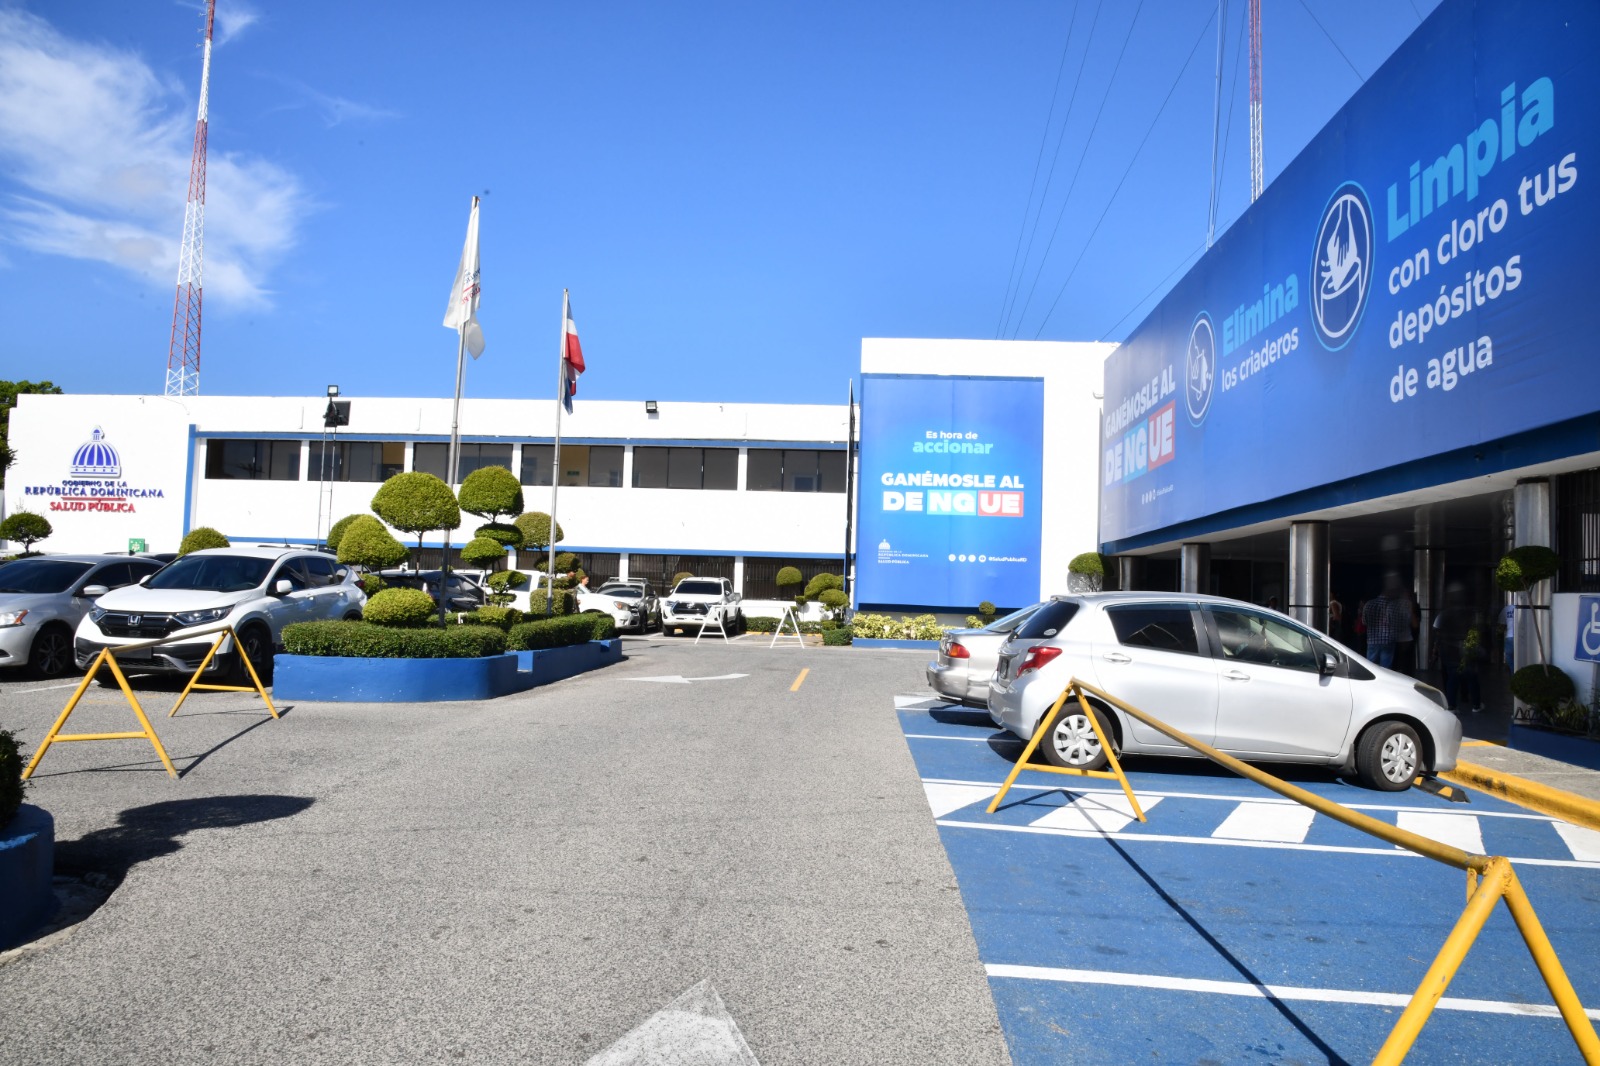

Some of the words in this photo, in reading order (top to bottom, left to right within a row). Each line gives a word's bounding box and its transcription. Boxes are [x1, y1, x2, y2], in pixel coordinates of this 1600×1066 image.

[1387, 76, 1554, 243] Limpia
[1388, 248, 1430, 295] con
[1437, 198, 1508, 265] cloro
[1518, 152, 1578, 216] tus
[1223, 273, 1299, 357] Elimina
[1389, 254, 1523, 349] depósitos
[1222, 366, 1237, 393] los
[1240, 327, 1299, 381] criaderos
[1389, 364, 1418, 403] de
[1426, 335, 1493, 392] agua
[925, 431, 938, 439] Es
[940, 431, 962, 439] hora
[965, 431, 978, 439] de
[1105, 375, 1158, 439] GANÉMOSLE
[1160, 364, 1176, 399] AL
[881, 470, 996, 488] GANÉMOSLE
[999, 475, 1025, 489] AL
[912, 440, 994, 454] accionar
[25, 485, 87, 497] REPÚBLICA
[90, 487, 165, 498] DOMINICANA
[50, 501, 87, 512] SALUD
[88, 499, 136, 513] PÚBLICA
